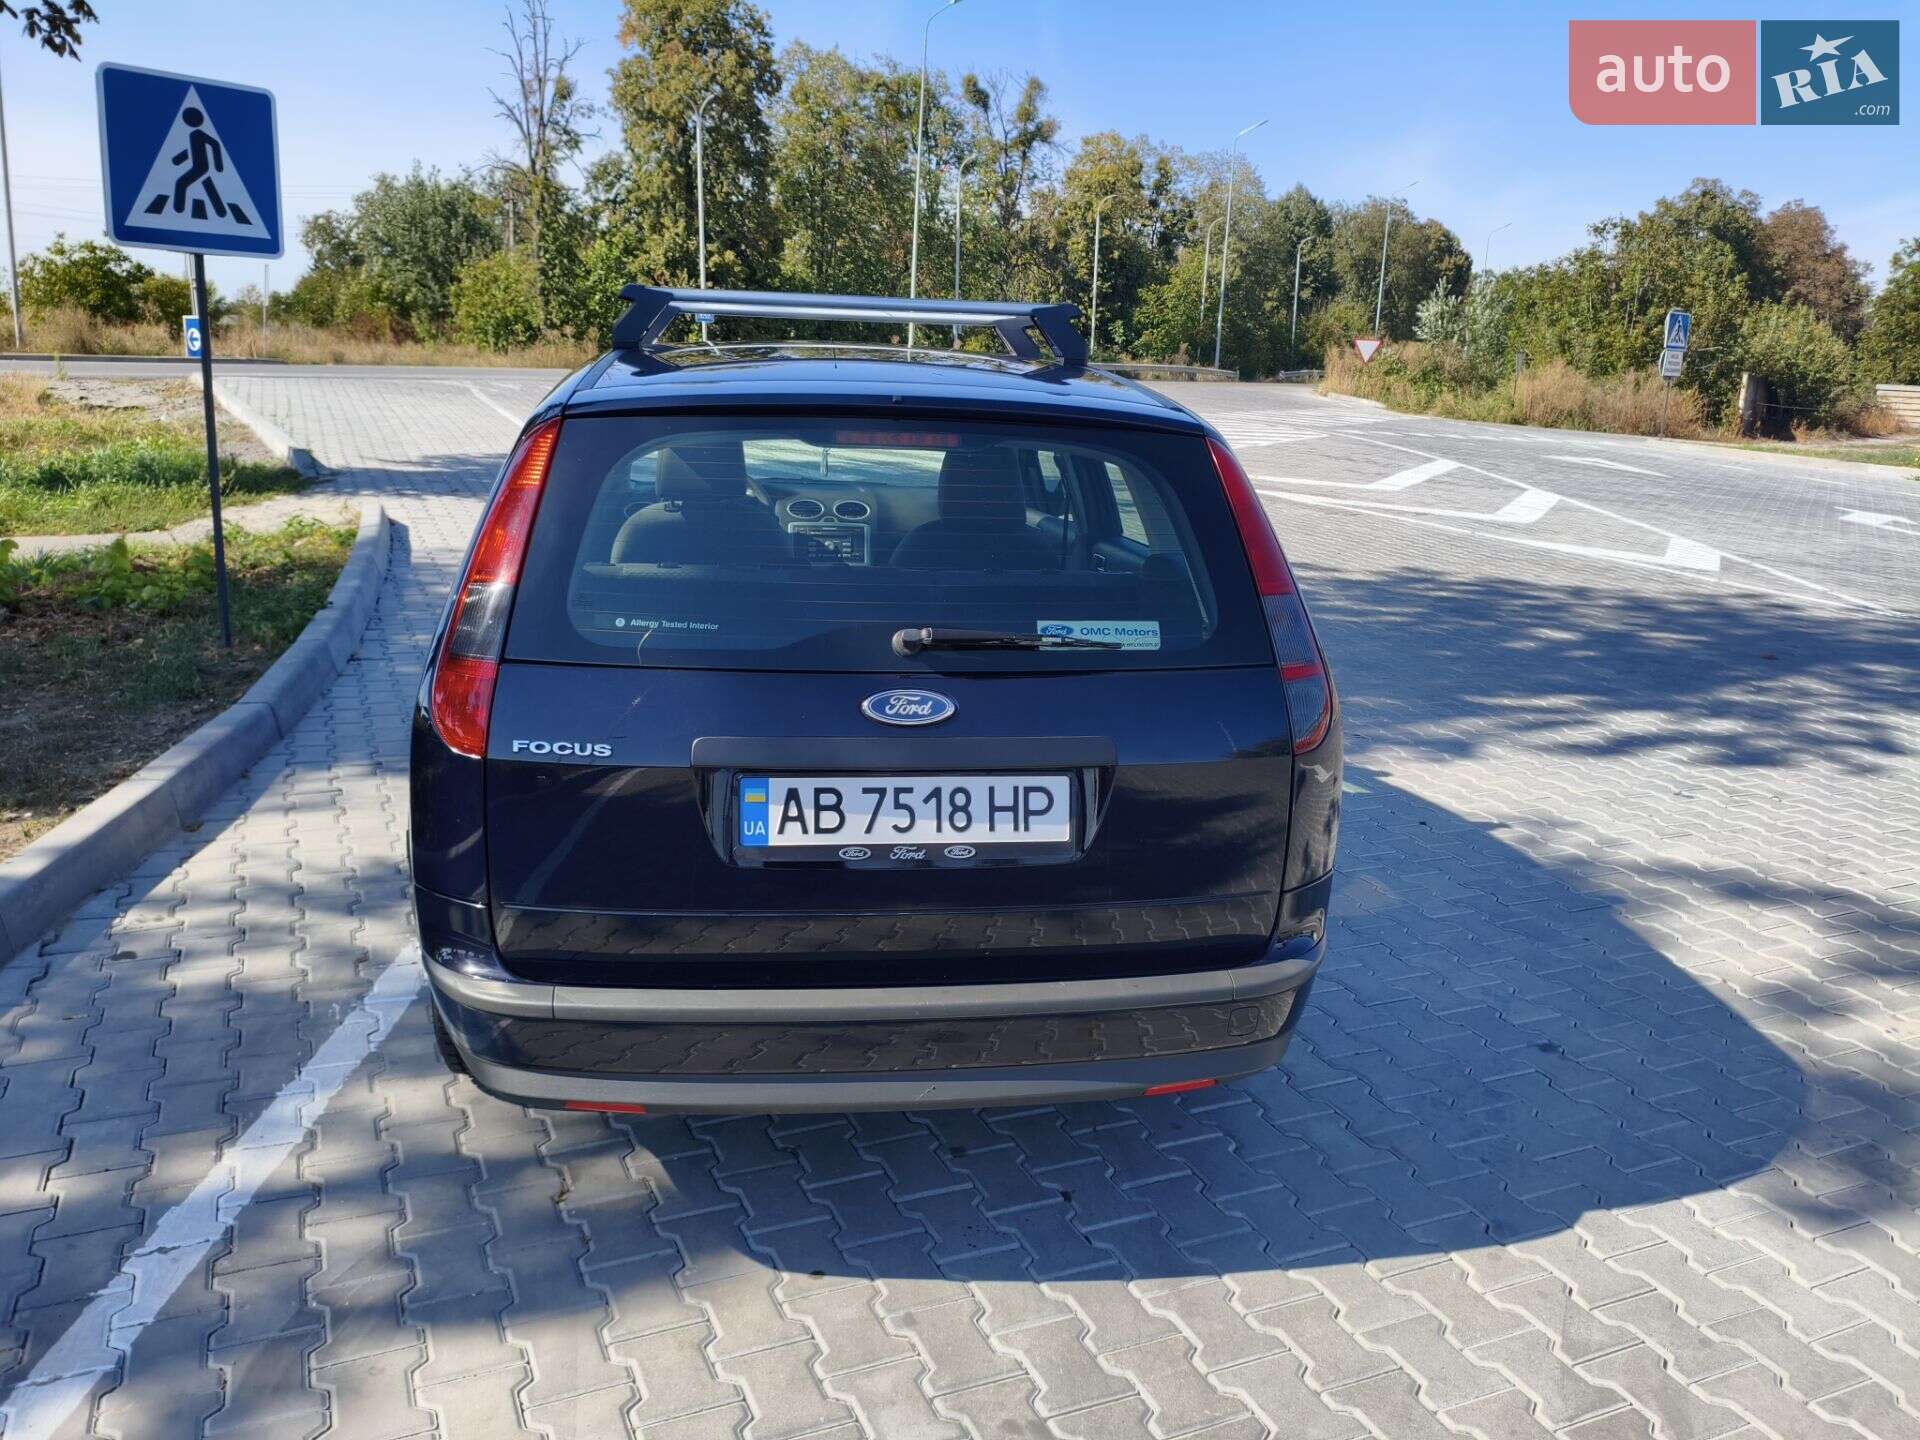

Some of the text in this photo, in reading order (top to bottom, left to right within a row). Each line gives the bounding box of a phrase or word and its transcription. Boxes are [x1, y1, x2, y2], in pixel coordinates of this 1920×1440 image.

[630, 618, 720, 630] Allergy Tested Interior
[1080, 627, 1159, 637] OMC Motors
[885, 695, 933, 715] Ford
[512, 739, 612, 757] FOCUS
[776, 785, 1055, 835] AB 7518 HP
[743, 820, 766, 836] UA
[889, 846, 927, 860] Ford
